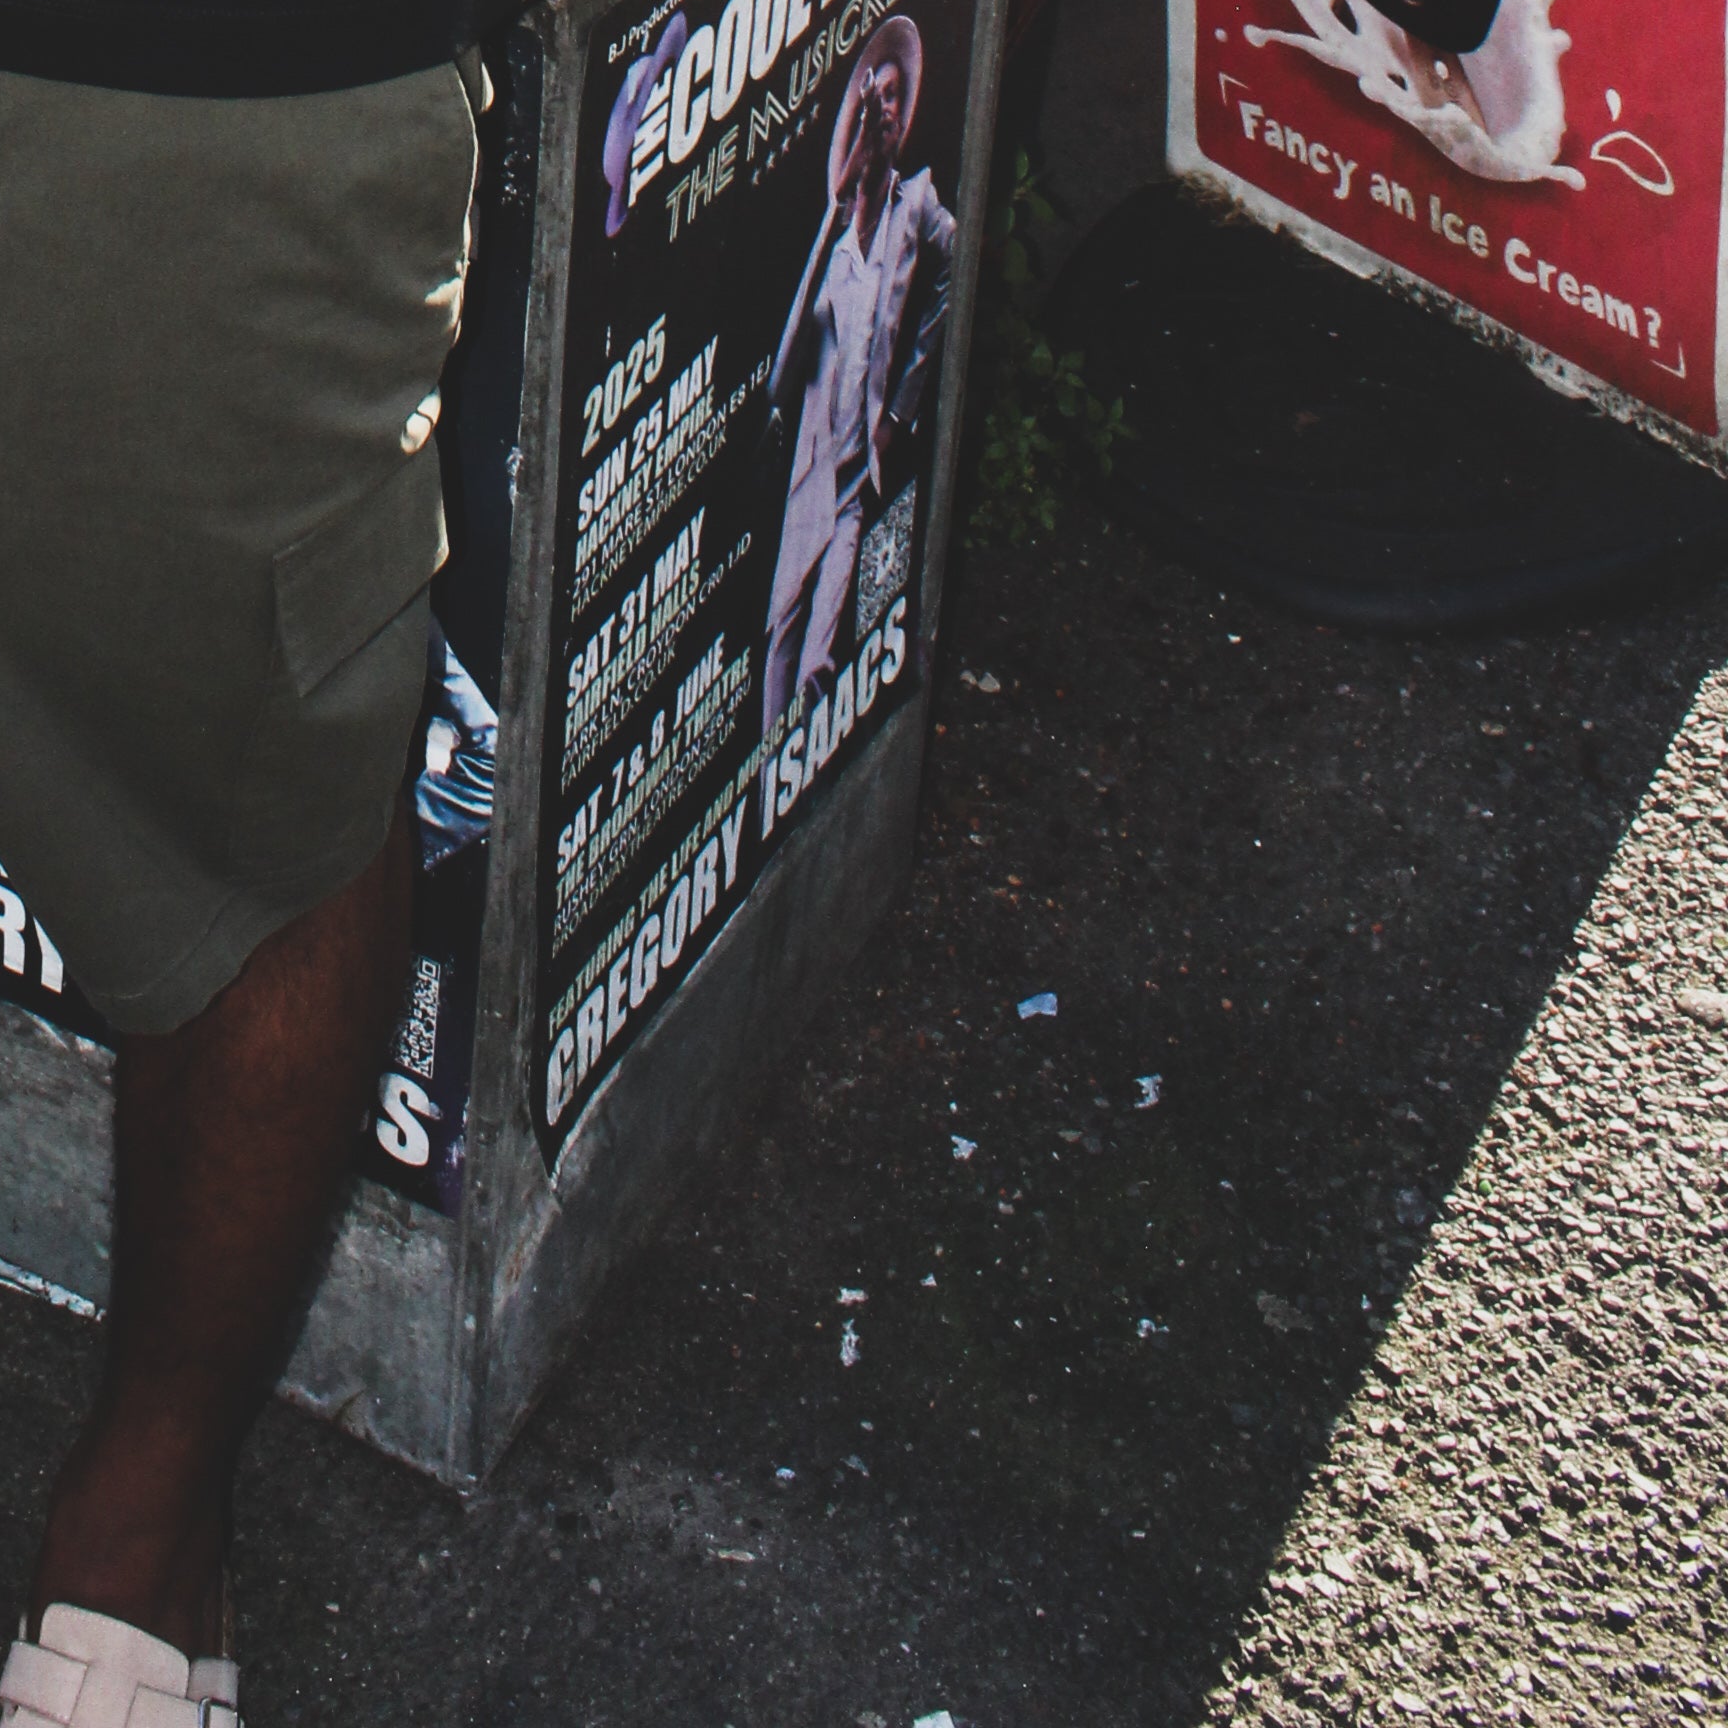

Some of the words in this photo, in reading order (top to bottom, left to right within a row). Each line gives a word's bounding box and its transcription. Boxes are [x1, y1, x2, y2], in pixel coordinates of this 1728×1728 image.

[665, 124, 740, 244] THE
[1238, 99, 1358, 201] Fancy
[1370, 170, 1417, 223] an
[1429, 194, 1489, 259] Ice
[575, 453, 654, 574] HACKNEY
[655, 383, 716, 480] EMPIRE
[577, 437, 628, 532] SUN
[630, 397, 664, 472] 25
[667, 334, 719, 431] MAY
[581, 312, 667, 459] 2025
[602, 504, 643, 566] MARE
[667, 403, 728, 487] LONDON
[729, 383, 747, 415] E8
[561, 713, 598, 774] PARK
[626, 596, 697, 691] CROYDON
[565, 622, 648, 749] FAIRFIELD
[650, 559, 701, 645] HALLS
[566, 611, 616, 709] SAT
[619, 572, 649, 645] 31
[652, 504, 706, 608] MAY
[555, 849, 586, 911] THE
[588, 729, 682, 870] BROADWAY
[684, 645, 752, 748] THEATRE
[556, 783, 604, 876] SAT
[627, 743, 646, 788] &
[650, 708, 666, 760] 8
[673, 632, 725, 732] JUNE
[762, 595, 907, 842] ISAACS
[548, 905, 636, 1043] FEATURING
[638, 861, 669, 920] THE
[670, 820, 702, 881] LIFE
[702, 778, 736, 842] AND
[735, 711, 786, 797] MUSIC
[786, 685, 807, 729] OF
[552, 854, 607, 937] RUSHEY
[643, 737, 702, 821] LONDON
